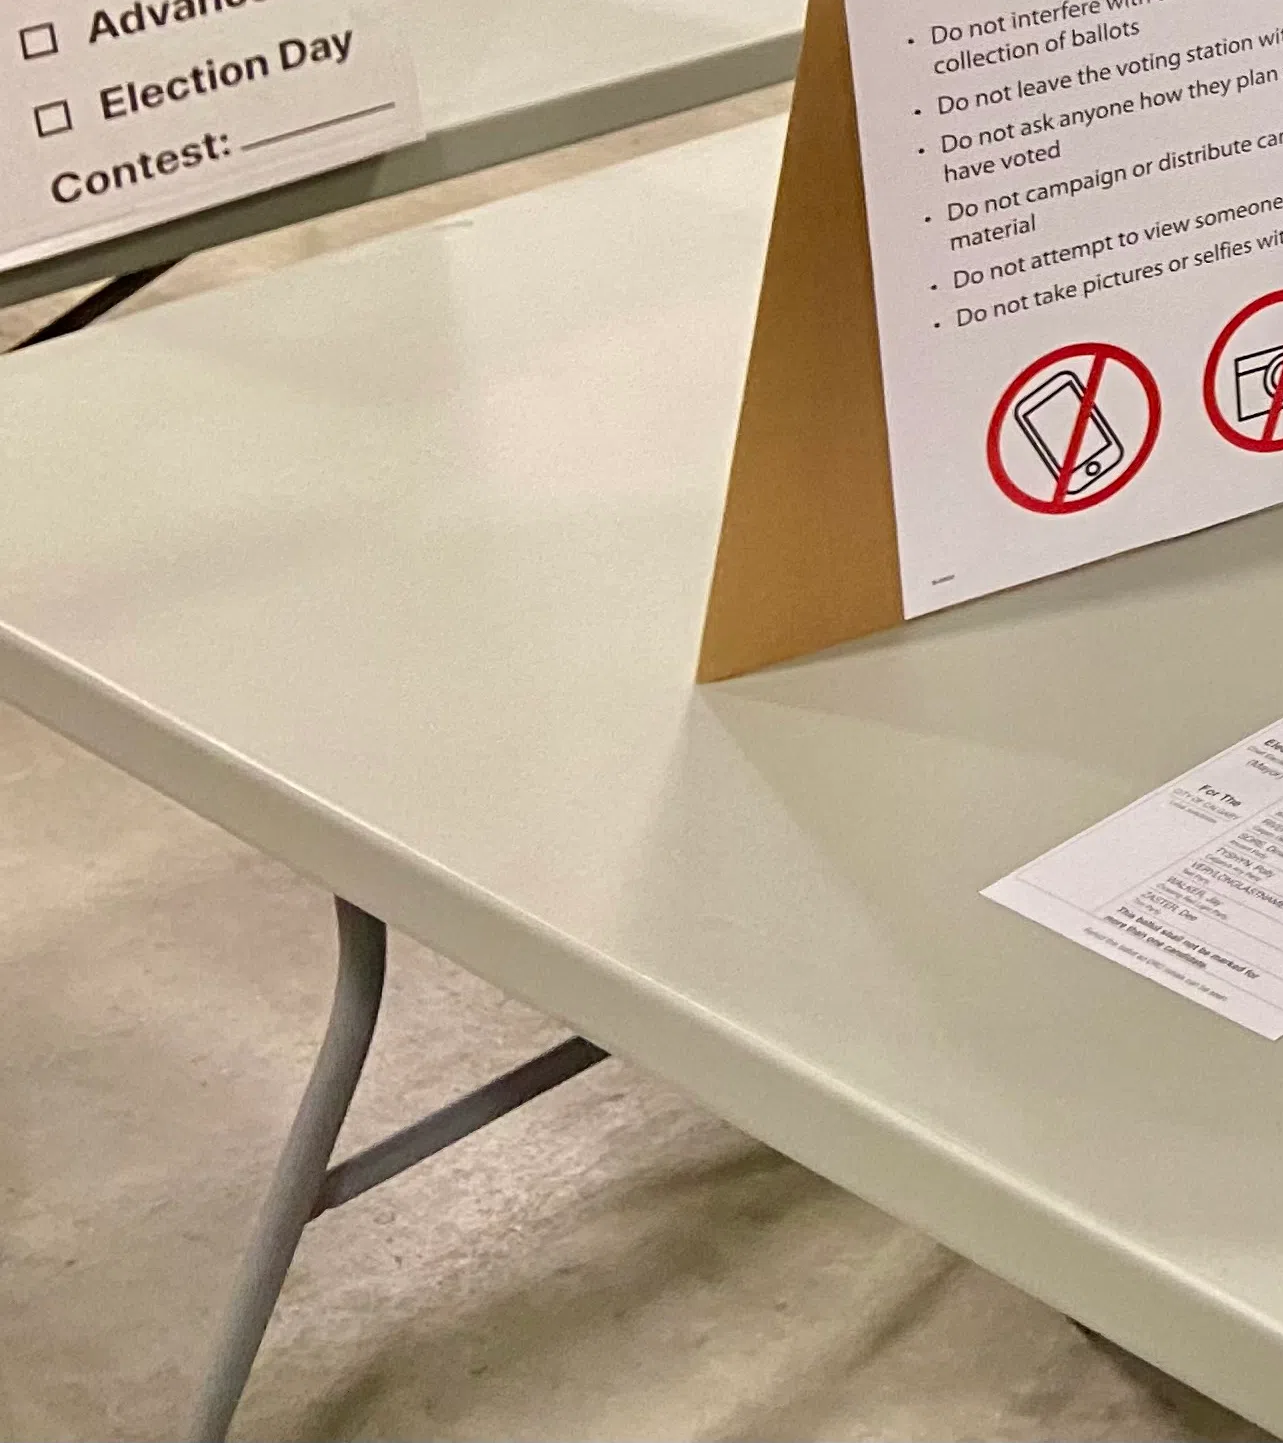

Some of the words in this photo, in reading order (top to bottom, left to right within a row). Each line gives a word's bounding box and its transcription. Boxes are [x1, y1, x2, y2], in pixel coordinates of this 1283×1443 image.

[930, 24, 963, 46] Do
[968, 15, 1007, 39] not
[1010, 0, 1101, 30] interfere
[932, 41, 1040, 75] collection
[1044, 29, 1067, 53] of
[1070, 20, 1141, 48] ballots
[99, 47, 270, 121] Election
[279, 29, 354, 73] Day
[936, 94, 970, 116] Do
[974, 84, 1012, 108] not
[1016, 74, 1073, 99] leave
[1076, 64, 1112, 86] the
[1114, 51, 1181, 77] voting
[1185, 36, 1254, 64] station
[940, 133, 973, 154] Do
[978, 122, 1016, 146] not
[1019, 112, 1056, 137] ask
[1059, 98, 1135, 128] anyone
[1139, 87, 1183, 110] how
[1186, 77, 1232, 100] they
[1235, 68, 1279, 94] plan
[50, 130, 231, 205] Contest:
[943, 159, 997, 184] have
[998, 138, 1061, 170] voted
[946, 201, 979, 222] Do
[983, 190, 1021, 214] not
[1025, 167, 1127, 203] campaign
[1131, 160, 1153, 178] or
[1157, 138, 1253, 172] distribute
[949, 212, 1036, 252] material
[952, 269, 985, 290] Do
[989, 256, 1027, 280] not
[1030, 235, 1114, 270] attempt
[1116, 230, 1139, 248] to
[1142, 217, 1191, 241] view
[1194, 195, 1283, 230] someone
[956, 307, 988, 328] Do
[992, 294, 1030, 318] not
[1032, 282, 1078, 307] take
[1082, 262, 1164, 299] pictures
[1167, 255, 1189, 273] or
[1193, 239, 1253, 267] selfies
[1198, 784, 1220, 798] For
[1220, 793, 1242, 807] The
